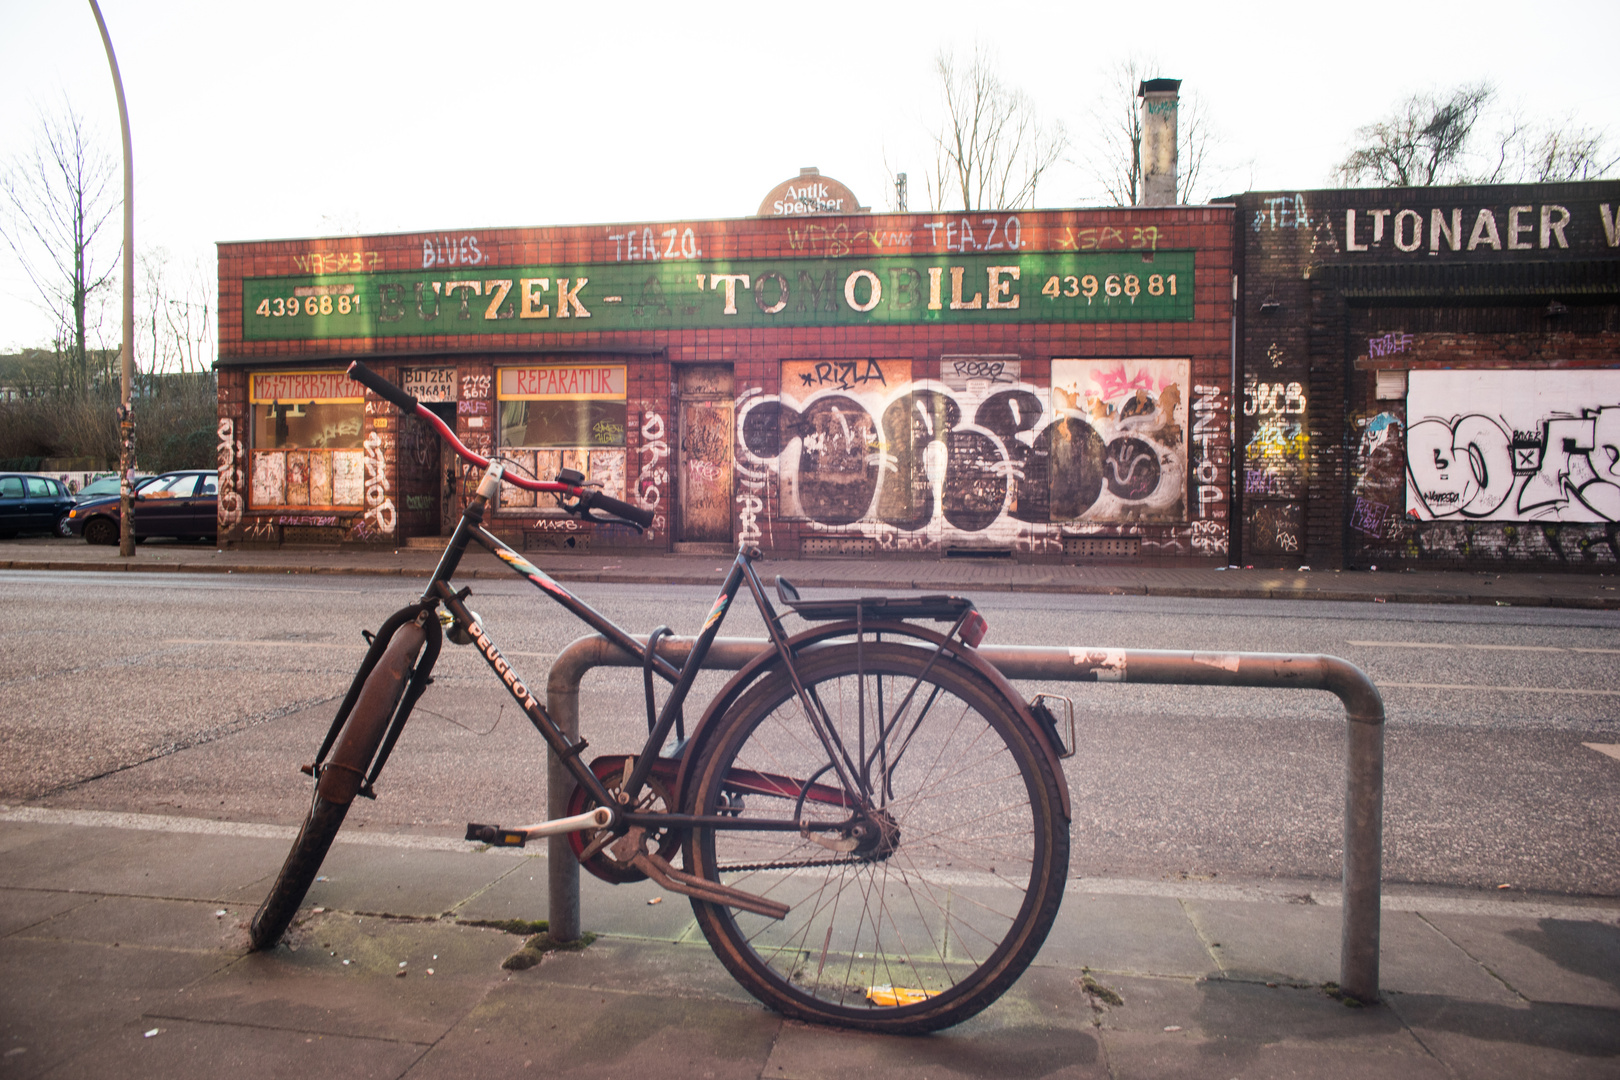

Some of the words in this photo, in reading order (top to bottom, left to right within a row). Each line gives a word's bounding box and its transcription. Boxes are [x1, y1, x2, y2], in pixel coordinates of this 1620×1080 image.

[784, 183, 829, 201] Antik
[773, 197, 844, 216] Speicher
[1041, 274, 1099, 298] 439
[1104, 274, 1141, 298] 68
[1147, 273, 1177, 297] 81
[256, 297, 300, 318] 439
[305, 295, 333, 316] 68
[337, 294, 362, 315] 81
[378, 277, 592, 321] BUTZEK
[404, 368, 454, 384] BUTZEK
[516, 369, 613, 395] REPARATUR
[467, 621, 538, 711] PEUGEOT
